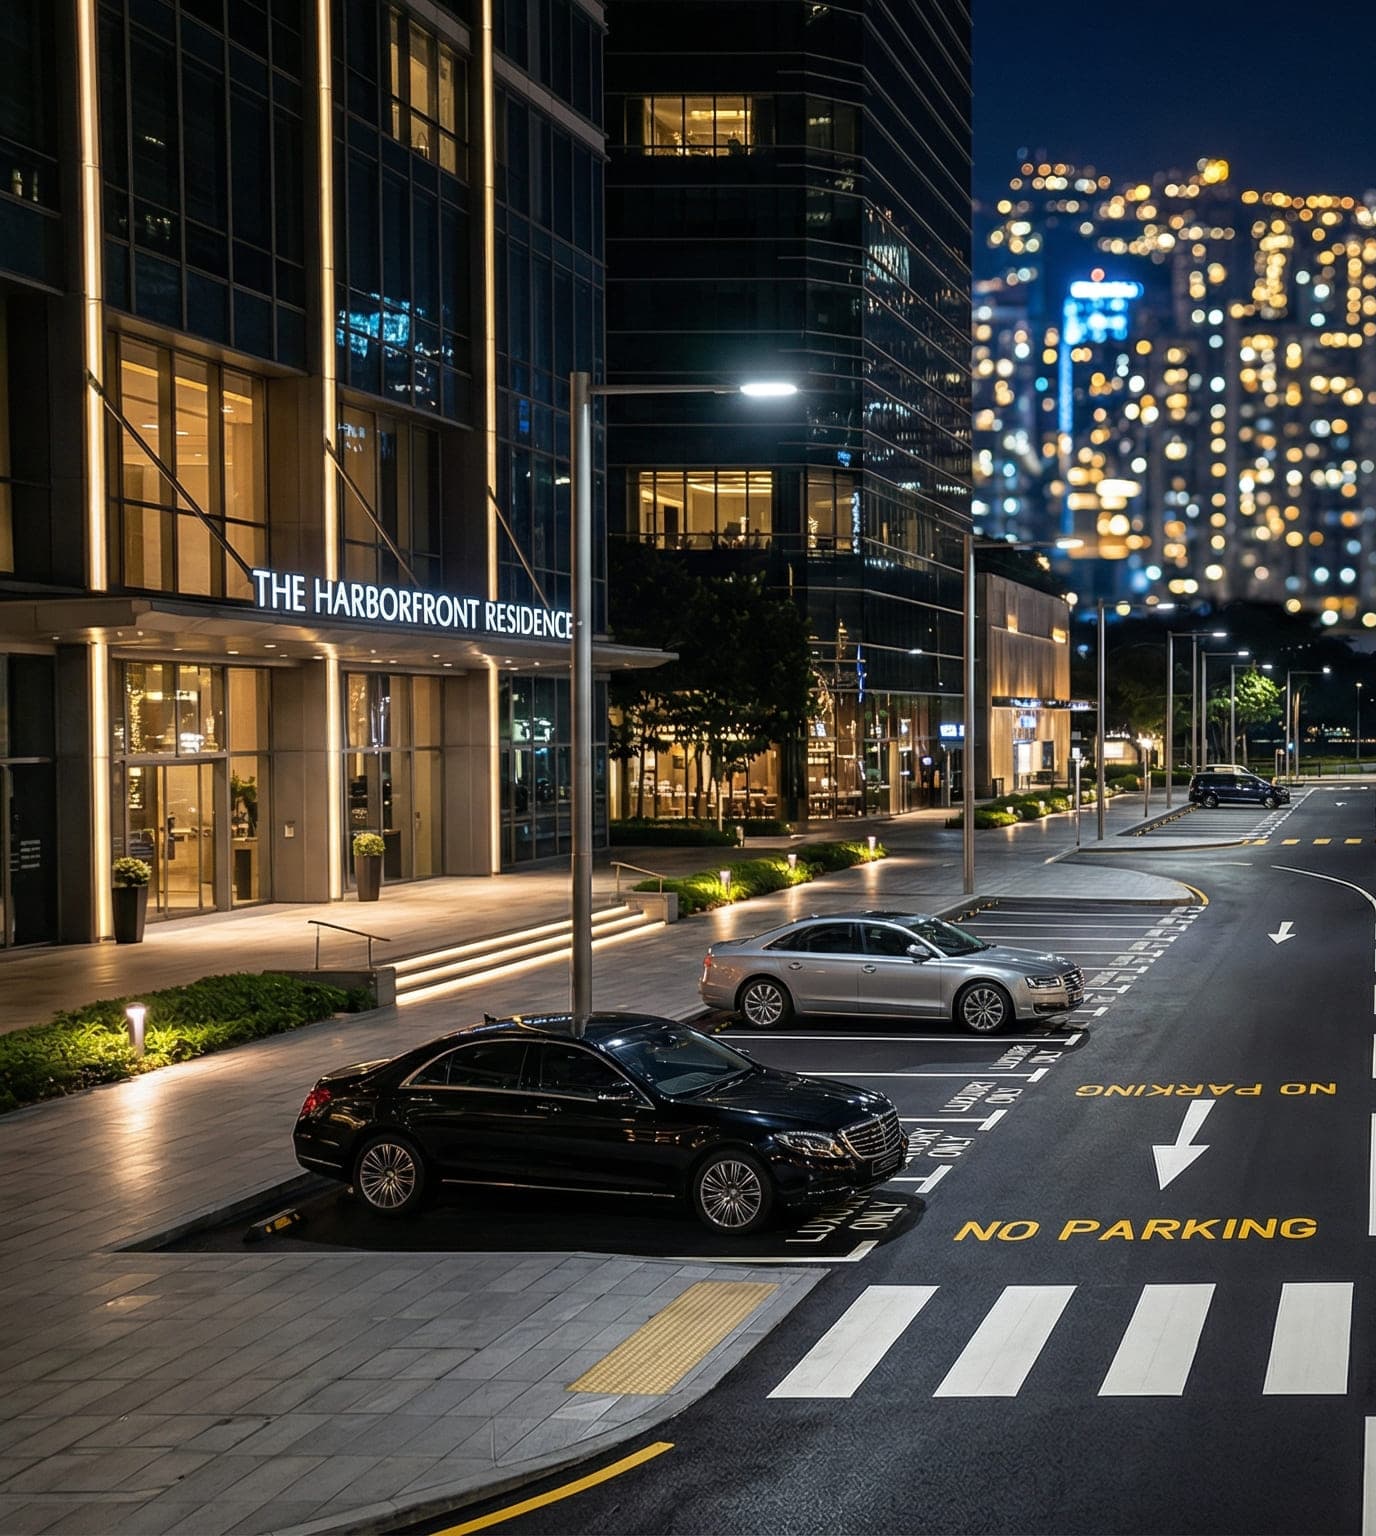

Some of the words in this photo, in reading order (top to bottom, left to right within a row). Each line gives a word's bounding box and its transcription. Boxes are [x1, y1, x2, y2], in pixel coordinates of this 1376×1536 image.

[252, 569, 306, 613] THE
[315, 578, 480, 630] HARBORFRONT
[485, 602, 573, 639] RESIDENCE
[1074, 1083, 1263, 1097] PARKING
[1280, 1082, 1338, 1096] NO
[785, 1195, 871, 1243] LUXU
[848, 1201, 908, 1231] ONLY
[953, 1220, 1040, 1241] NO
[1058, 1217, 1319, 1241] PARKING
